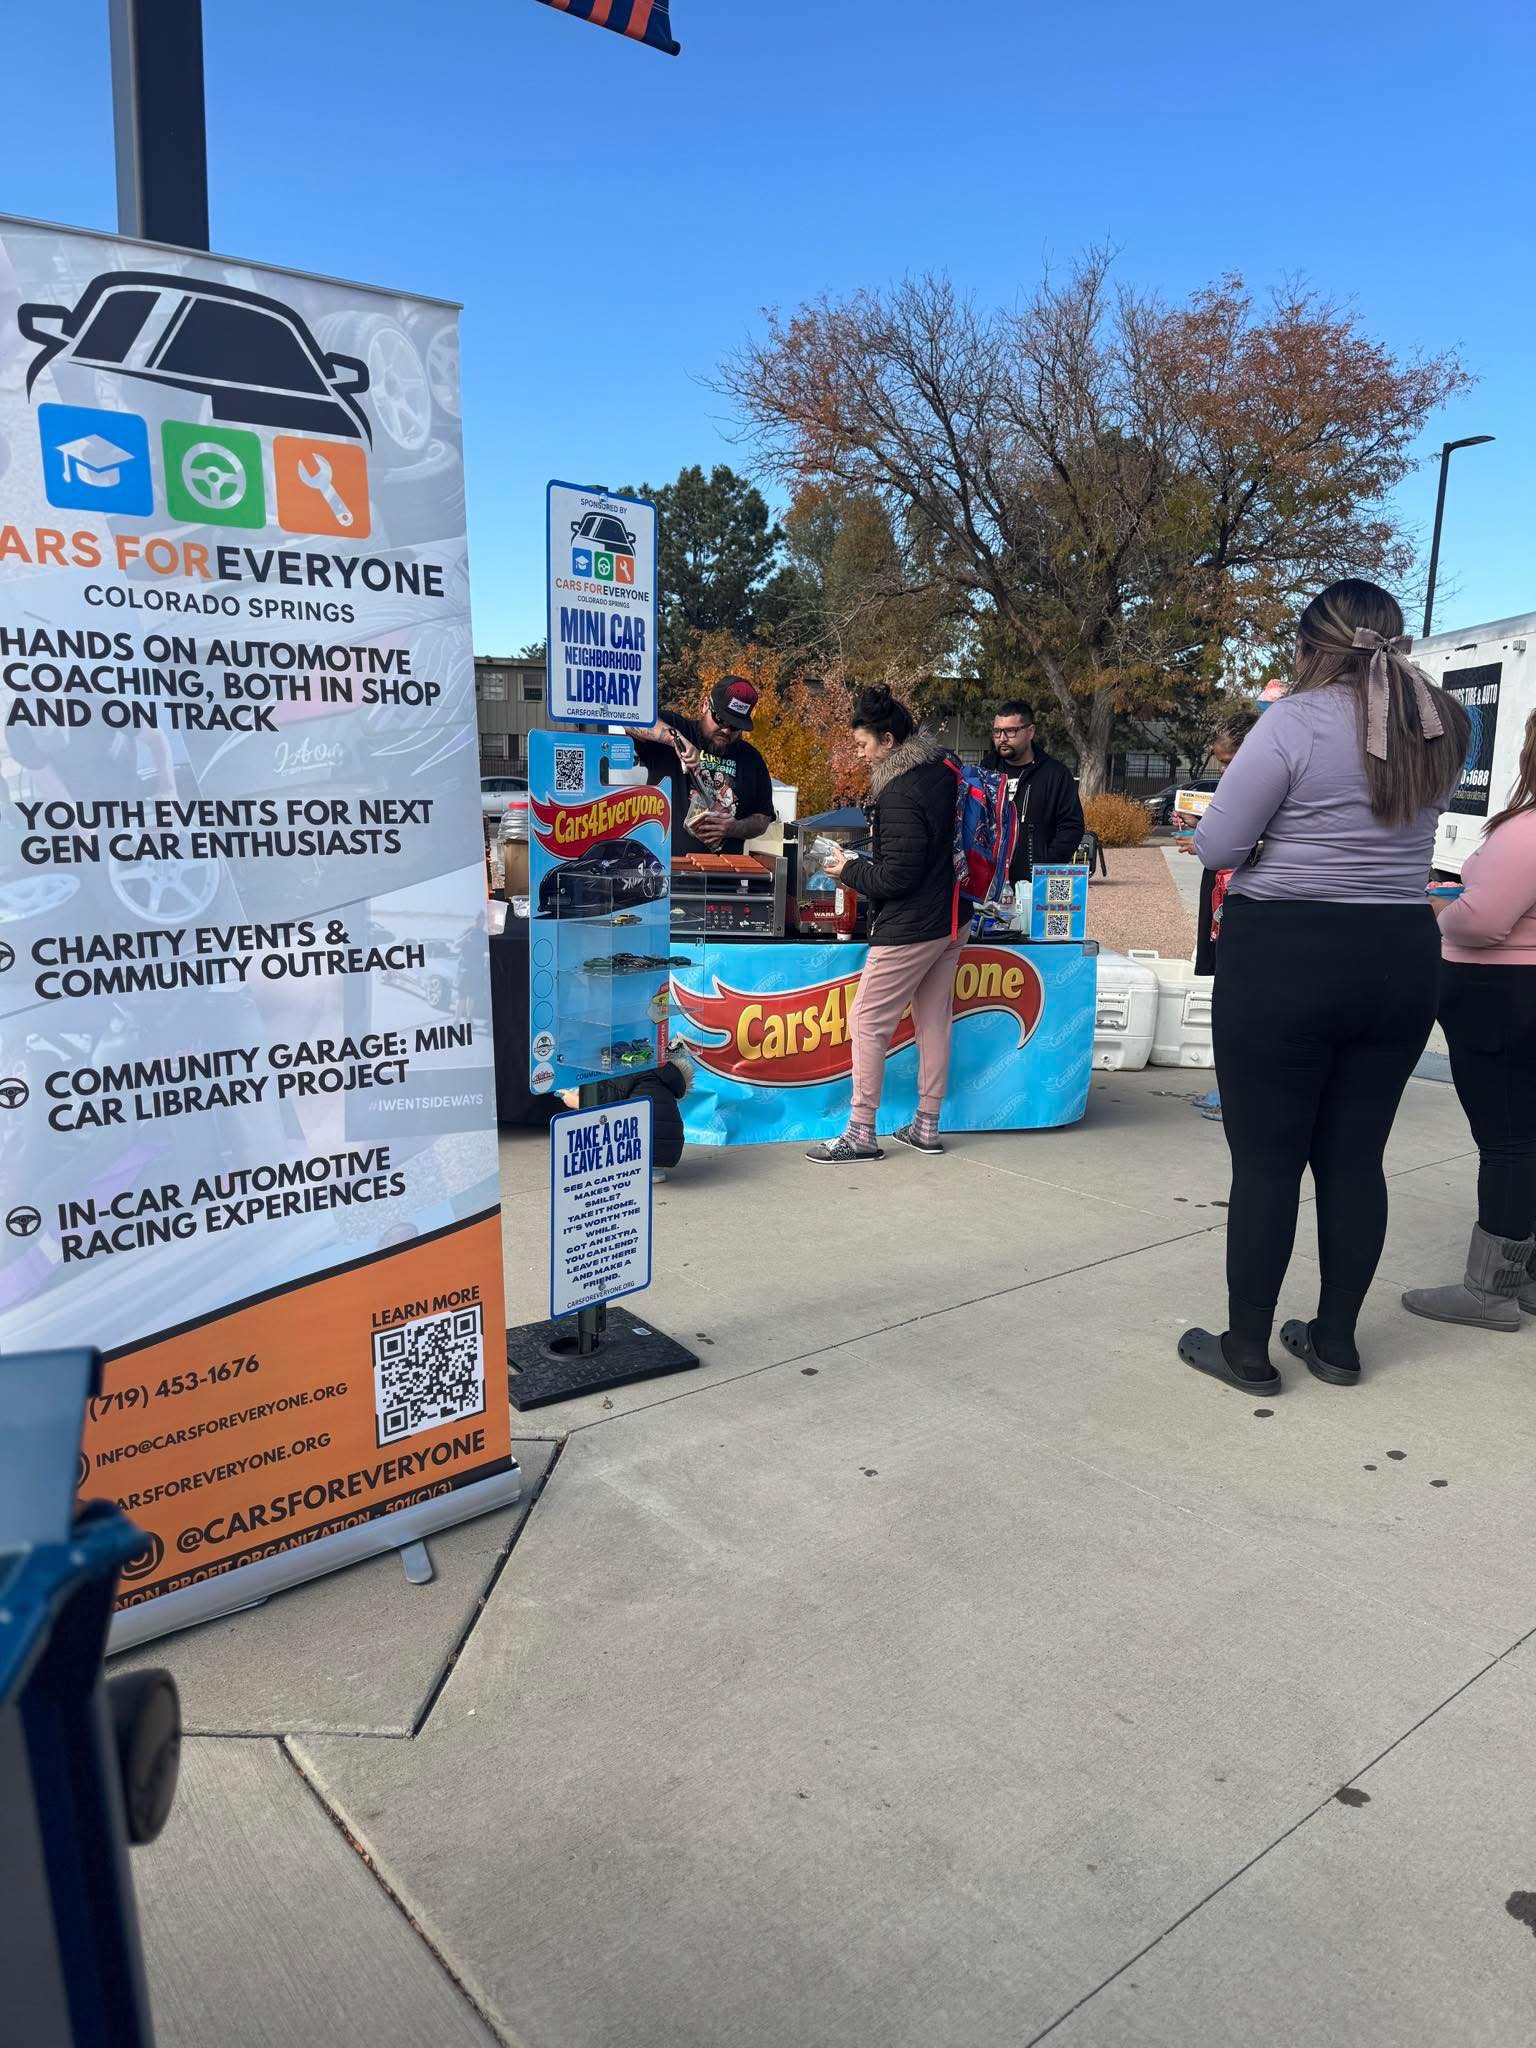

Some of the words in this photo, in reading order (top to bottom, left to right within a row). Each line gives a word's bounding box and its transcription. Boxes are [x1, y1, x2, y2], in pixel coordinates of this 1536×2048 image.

[580, 498, 618, 513] SPONSORED
[619, 506, 628, 515] BY
[0, 525, 101, 568] ARS
[555, 577, 582, 593] CARS
[577, 595, 608, 607] COLORADO
[608, 599, 630, 609] SPRINGS
[84, 585, 240, 616] COLORADO
[248, 598, 355, 623] SPRINGS
[560, 606, 606, 647] MINI
[610, 613, 646, 651] CAR
[0, 627, 133, 661] HANDS
[143, 635, 197, 665] ON
[206, 641, 411, 675] AUTOMOTIVE
[565, 645, 642, 672] NEIGHBORHOOD
[3, 662, 215, 703] COACHING,
[224, 672, 311, 702] BOTH
[320, 676, 353, 702] IN
[361, 678, 441, 706] SHOP
[566, 667, 642, 707] LIBRARY
[1465, 686, 1478, 706] TIRE
[1482, 683, 1498, 704] AUTO
[6, 698, 92, 727] AND
[101, 702, 159, 729] ON
[165, 703, 279, 732] TRACK
[566, 707, 640, 720] CARSFOREVERYONE.ORG
[14, 801, 143, 830] YOUTH
[156, 800, 278, 828] EVENTS
[287, 800, 349, 825] FOR
[360, 800, 433, 825] NEXT
[554, 796, 665, 844] Cars4Everyone
[20, 834, 99, 864] GEN
[109, 832, 182, 862] CAR
[191, 829, 402, 860] ENTHUSIASTS
[31, 929, 187, 966] CHARITY
[195, 921, 315, 954] EVENTS
[325, 919, 351, 944] &
[34, 956, 252, 1000] COMMUNITY
[260, 944, 426, 980] OUTREACH
[44, 1046, 260, 1100] COMMUNITY
[268, 1032, 407, 1070] GARAGE:
[414, 1022, 473, 1053] MINI
[47, 1096, 127, 1132] CAR
[135, 1076, 270, 1122] LIBRARY
[278, 1060, 410, 1098] PROJECT
[368, 1094, 484, 1112] #IWENTSIDEWAYS
[567, 1124, 600, 1154] TAKE
[603, 1122, 611, 1146] A
[613, 1116, 639, 1142] CAR
[563, 1148, 603, 1179] LEAVE
[605, 1144, 615, 1167] A
[616, 1137, 642, 1163] CAR
[58, 1183, 180, 1231] IN-CAR
[191, 1146, 391, 1206] AUTOMOTIVE
[563, 1182, 584, 1194] SEE
[584, 1180, 593, 1188] A
[594, 1175, 614, 1186] CAR
[614, 1168, 642, 1180] THAT
[574, 1186, 610, 1201] MAKES
[611, 1180, 632, 1191] YOU
[61, 1209, 197, 1263] RACING
[205, 1172, 407, 1234] EXPERIENCES
[567, 1210, 594, 1223] TAKE
[595, 1207, 605, 1216] IT
[584, 1193, 621, 1208] SMILE?
[563, 1224, 583, 1235] IT'S
[584, 1214, 620, 1228] WORTH
[621, 1207, 641, 1219] THE
[585, 1224, 620, 1238] WHILE.
[565, 1252, 585, 1265] YOU
[587, 1247, 607, 1259] CAN
[608, 1236, 639, 1252] LEND?
[566, 1242, 587, 1254] GOT
[589, 1237, 604, 1247] AN
[604, 1228, 638, 1242] EXTRA
[566, 1260, 599, 1275] LEAVE
[600, 1255, 610, 1265] IT
[611, 1248, 637, 1260] HERE
[571, 1271, 593, 1283] AND
[594, 1262, 623, 1276] MAKE
[623, 1258, 632, 1266] A
[567, 1281, 635, 1309] CARSFOREVERYONE.ORG
[583, 1272, 621, 1290] FRIEND.
[372, 1300, 428, 1328] LEARN
[432, 1285, 480, 1313] MORE
[89, 1385, 149, 1422] (719)
[154, 1354, 260, 1398] 453-1676
[96, 1382, 349, 1468] INFO@CARSFOREVERYONE.ORG
[116, 1432, 332, 1512] ARSFOREVERYONE.ORG
[176, 1429, 486, 1554] @CARSFOREVERYONE
